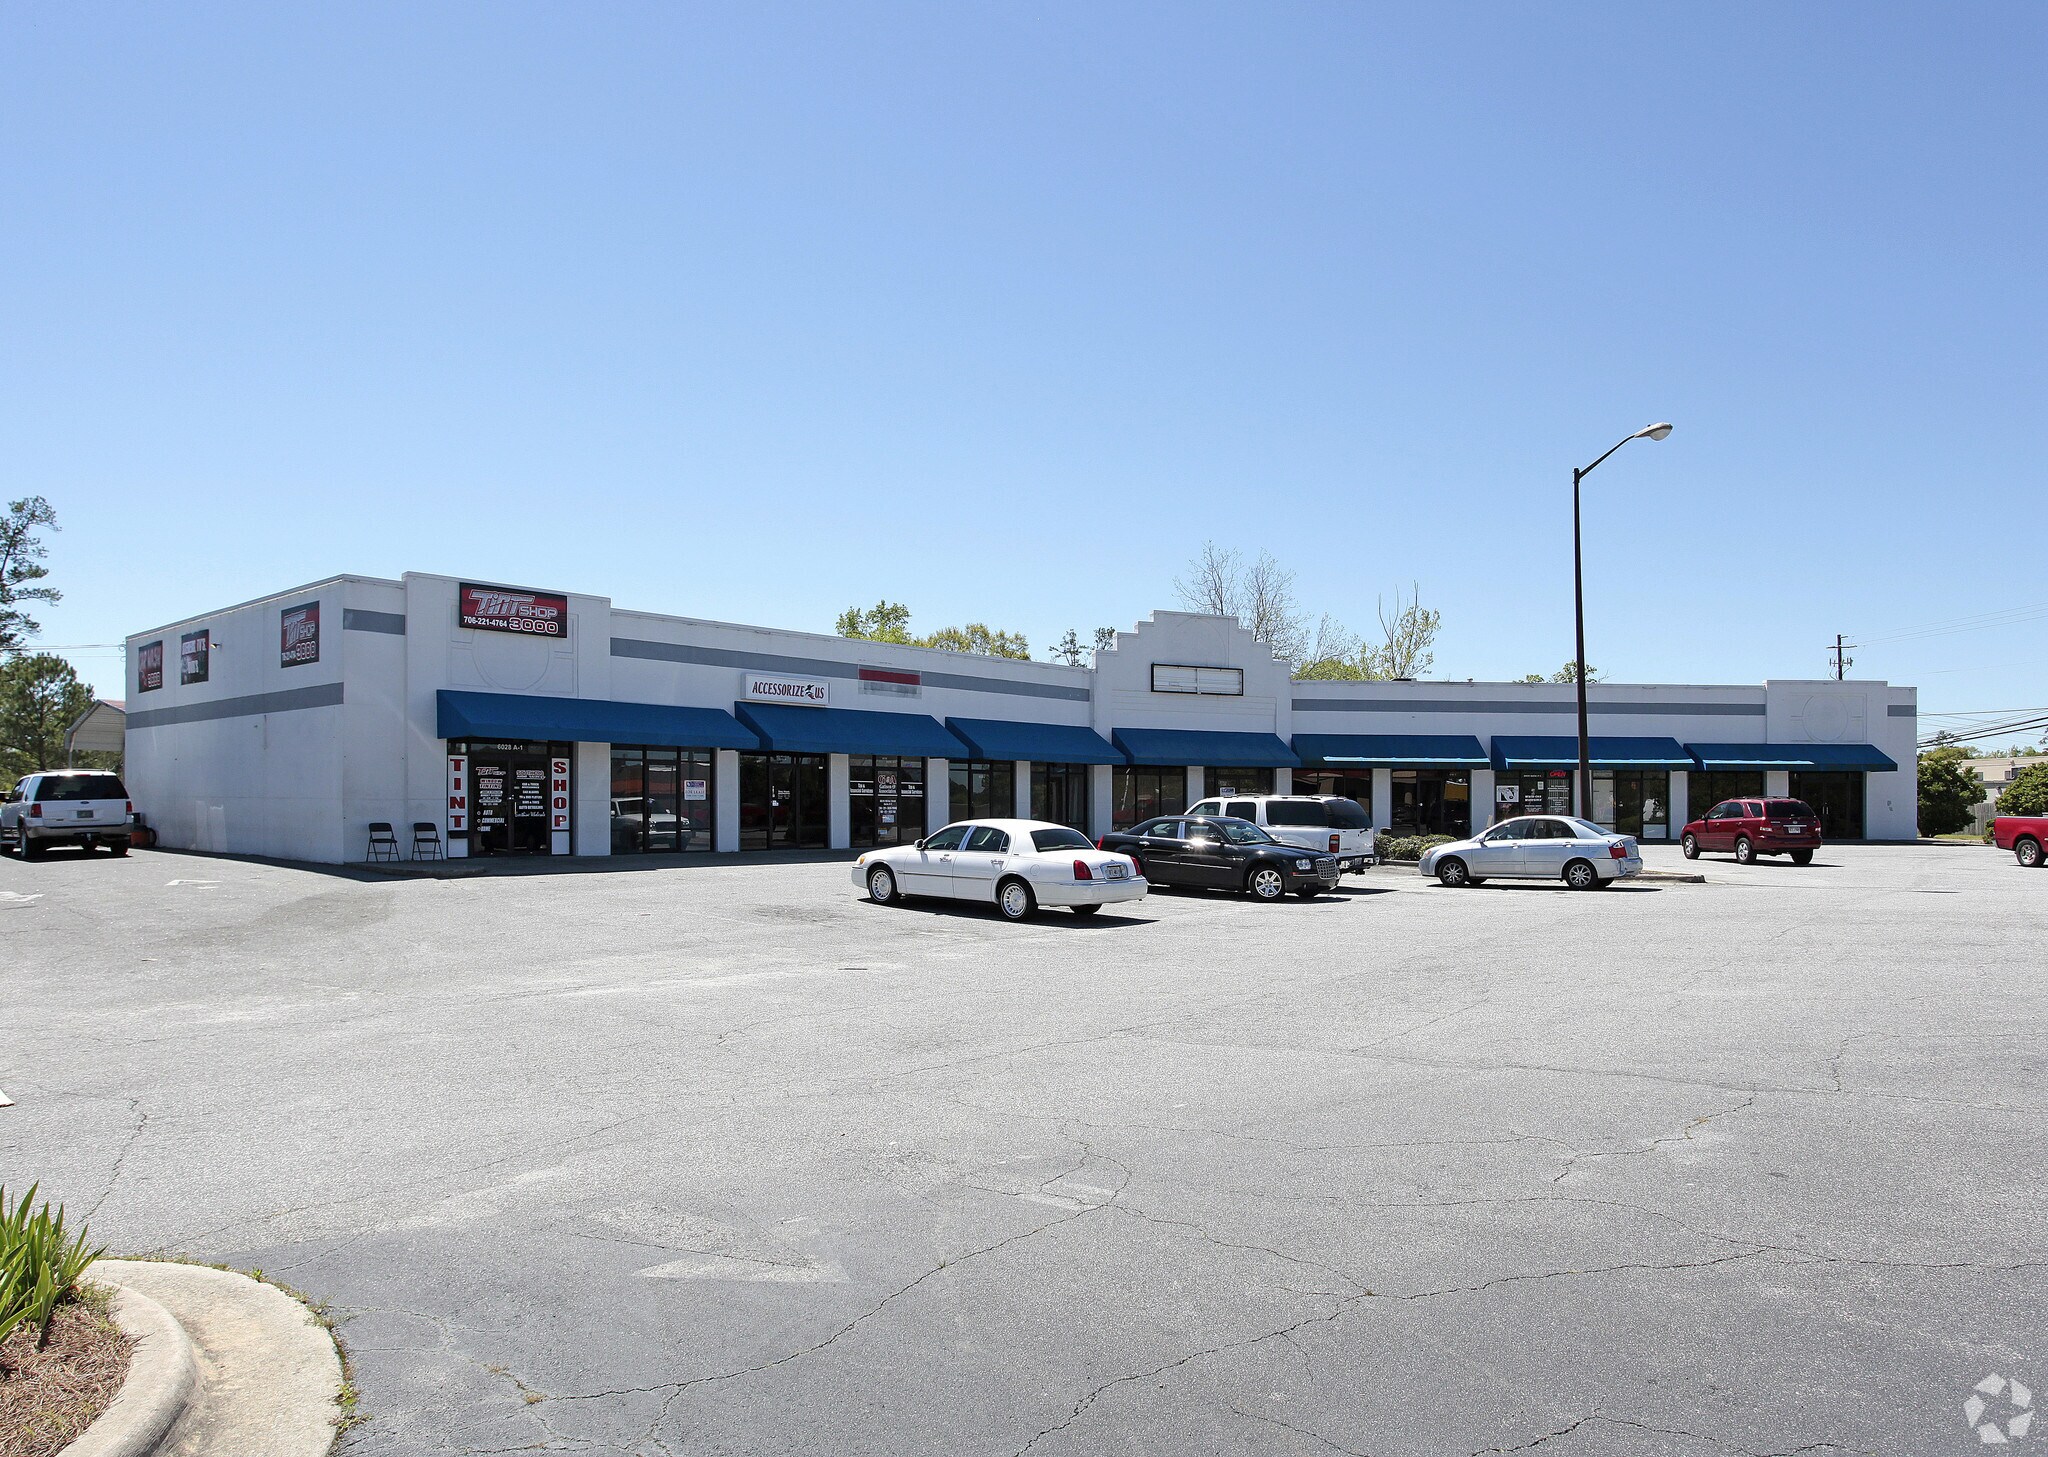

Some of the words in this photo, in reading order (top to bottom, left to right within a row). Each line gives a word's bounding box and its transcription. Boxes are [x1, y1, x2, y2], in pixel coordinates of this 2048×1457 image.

[519, 604, 558, 619] SHOP
[463, 616, 508, 627] 706-221-4764
[509, 617, 558, 634] 3000
[752, 681, 805, 698] ACCESSORIZE
[814, 687, 825, 699] US
[450, 759, 465, 827] TINT
[553, 761, 567, 827] SHOP
